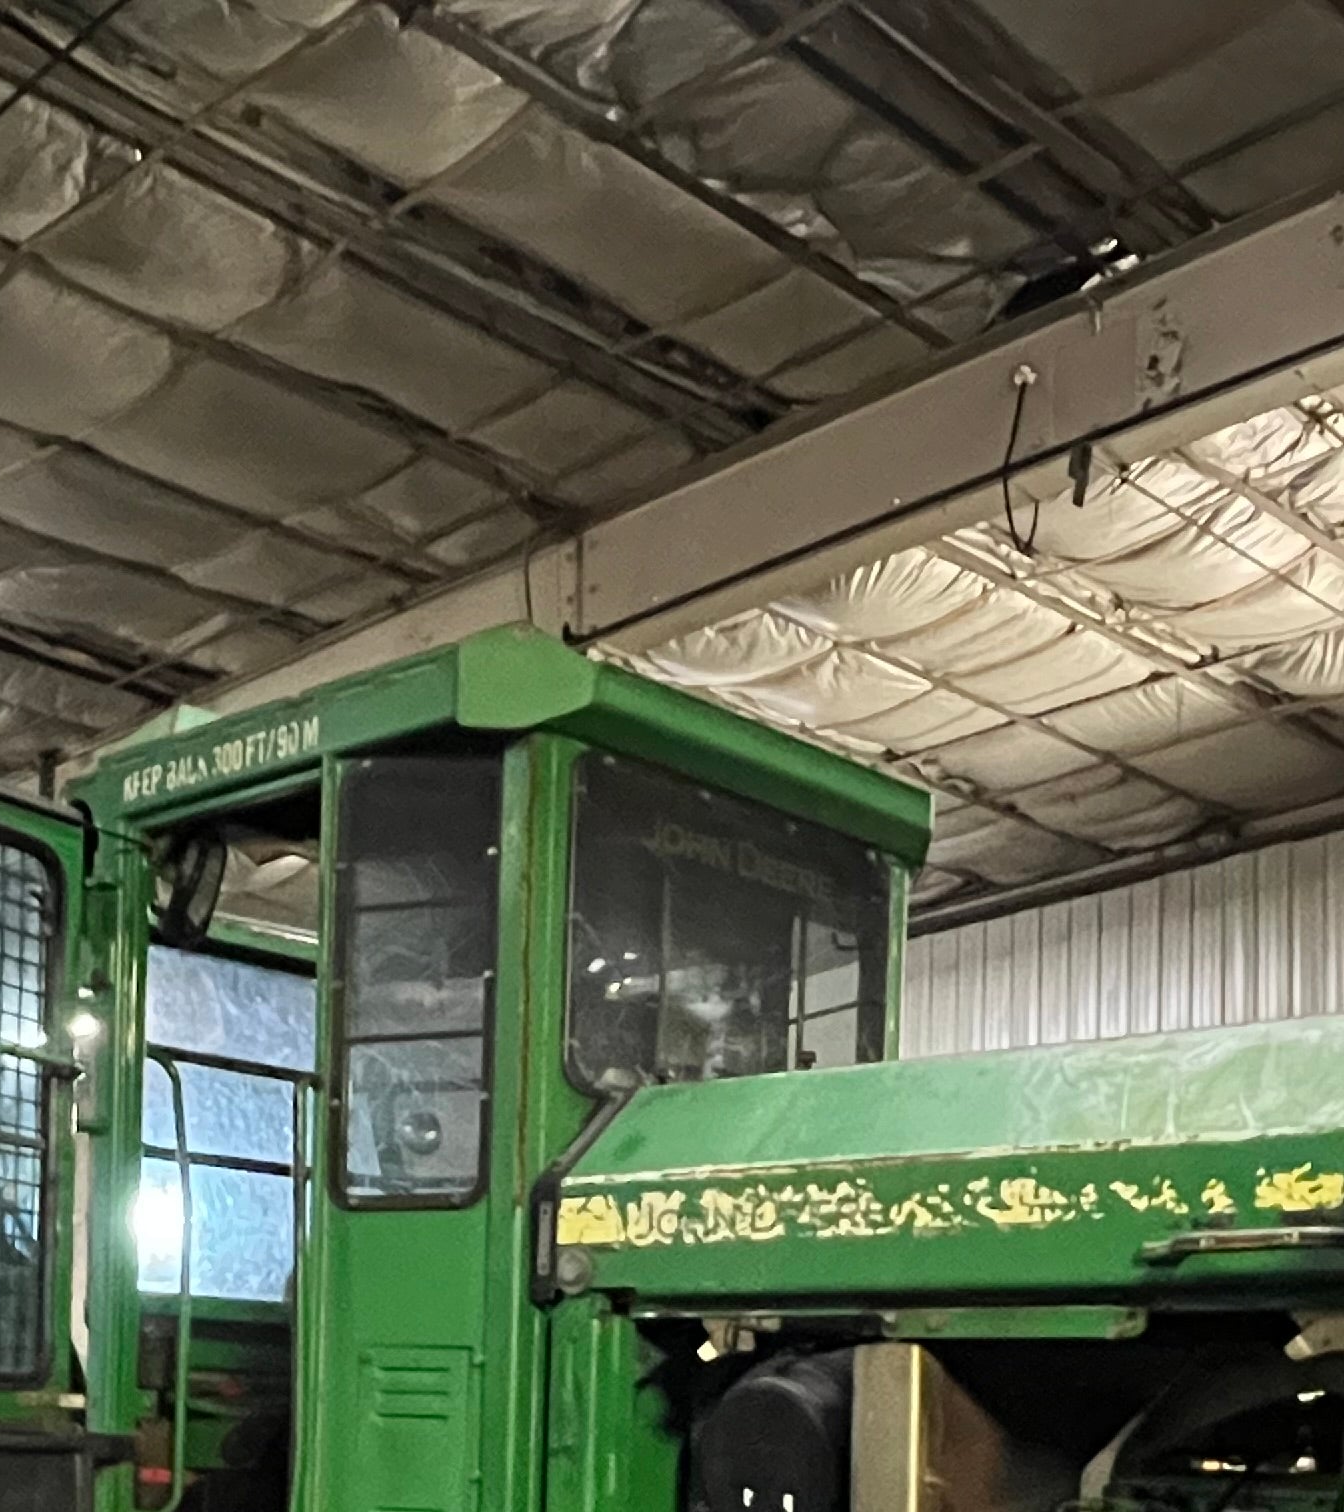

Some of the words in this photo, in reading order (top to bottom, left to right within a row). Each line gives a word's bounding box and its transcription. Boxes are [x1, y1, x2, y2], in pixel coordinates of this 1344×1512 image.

[123, 763, 163, 802] KEEP
[212, 739, 243, 776] 300
[737, 840, 832, 898] DEERE
